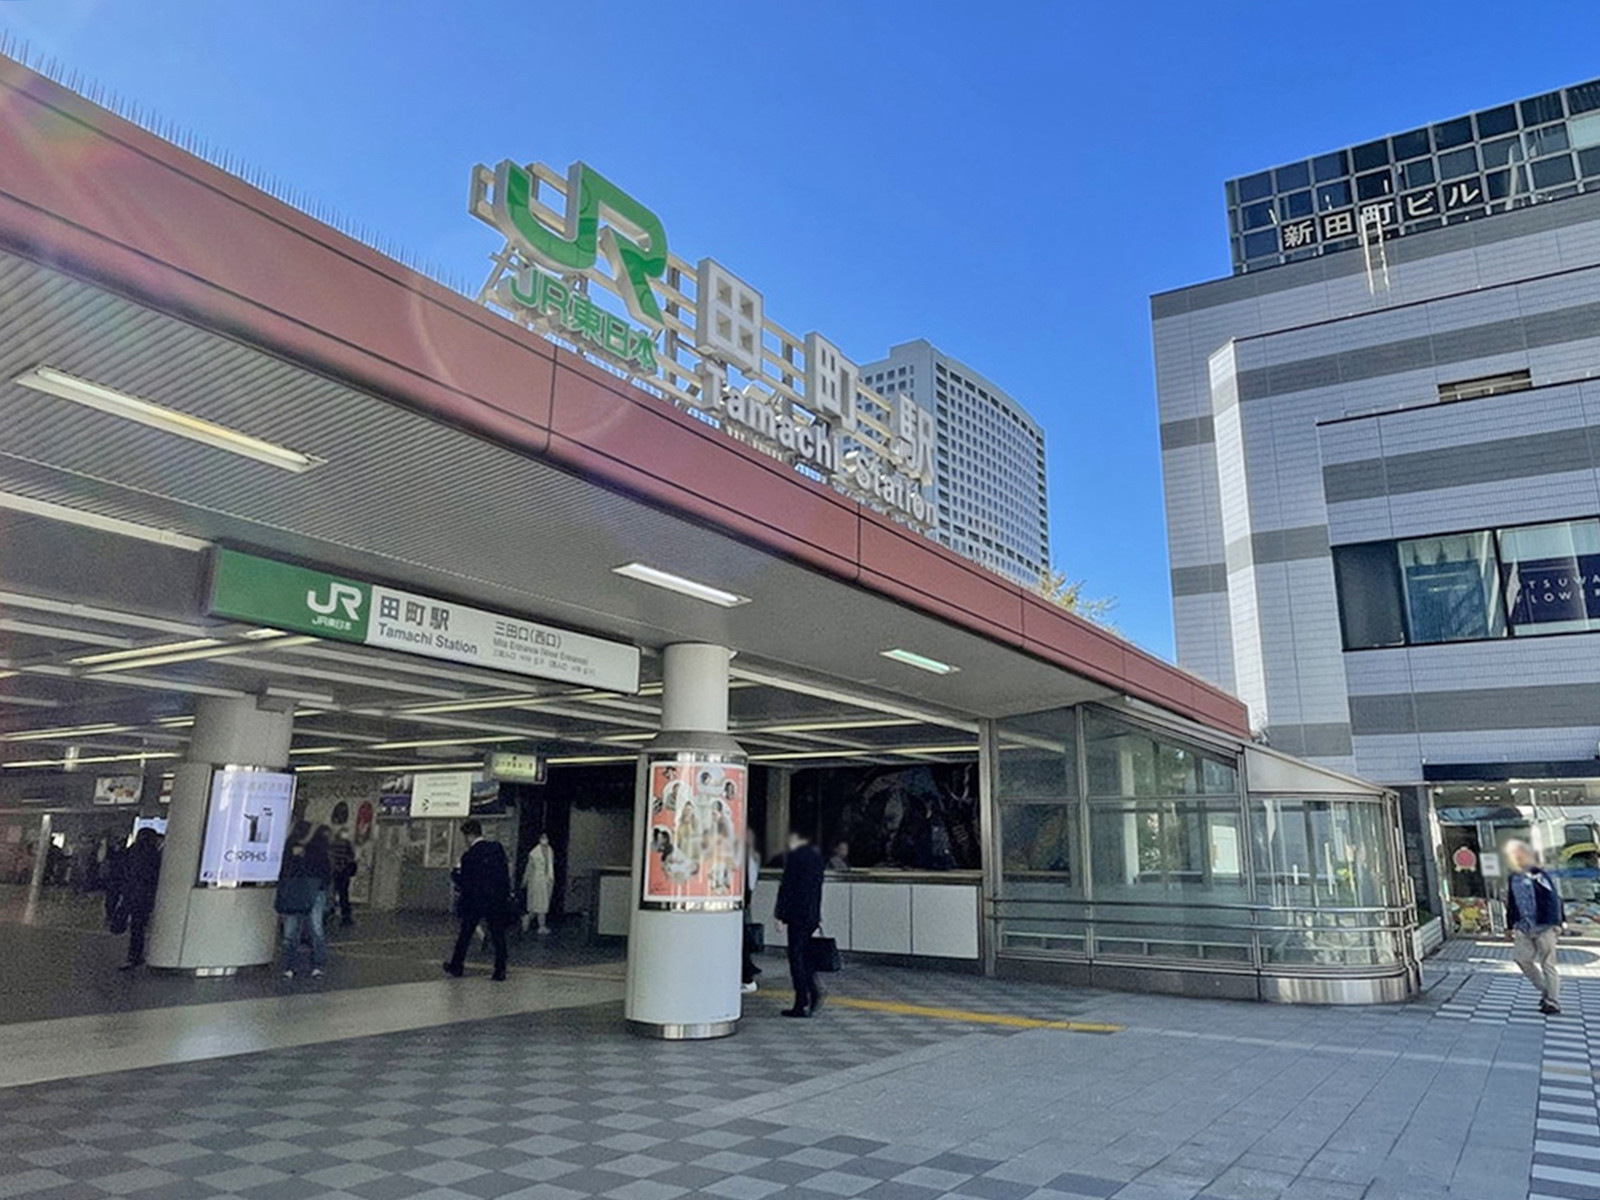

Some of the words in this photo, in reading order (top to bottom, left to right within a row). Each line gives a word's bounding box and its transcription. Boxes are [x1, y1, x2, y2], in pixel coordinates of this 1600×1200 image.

[495, 159, 668, 330] JR
[1283, 184, 1480, 247] 新田町ビル
[504, 267, 658, 375] JR東日本
[698, 257, 935, 486] 田町駅
[700, 362, 840, 473] Tamachi
[855, 453, 938, 527] Station
[306, 582, 362, 621] JR
[378, 622, 433, 646] Tamachi
[435, 634, 478, 655] Station
[379, 595, 450, 632] 田町駅
